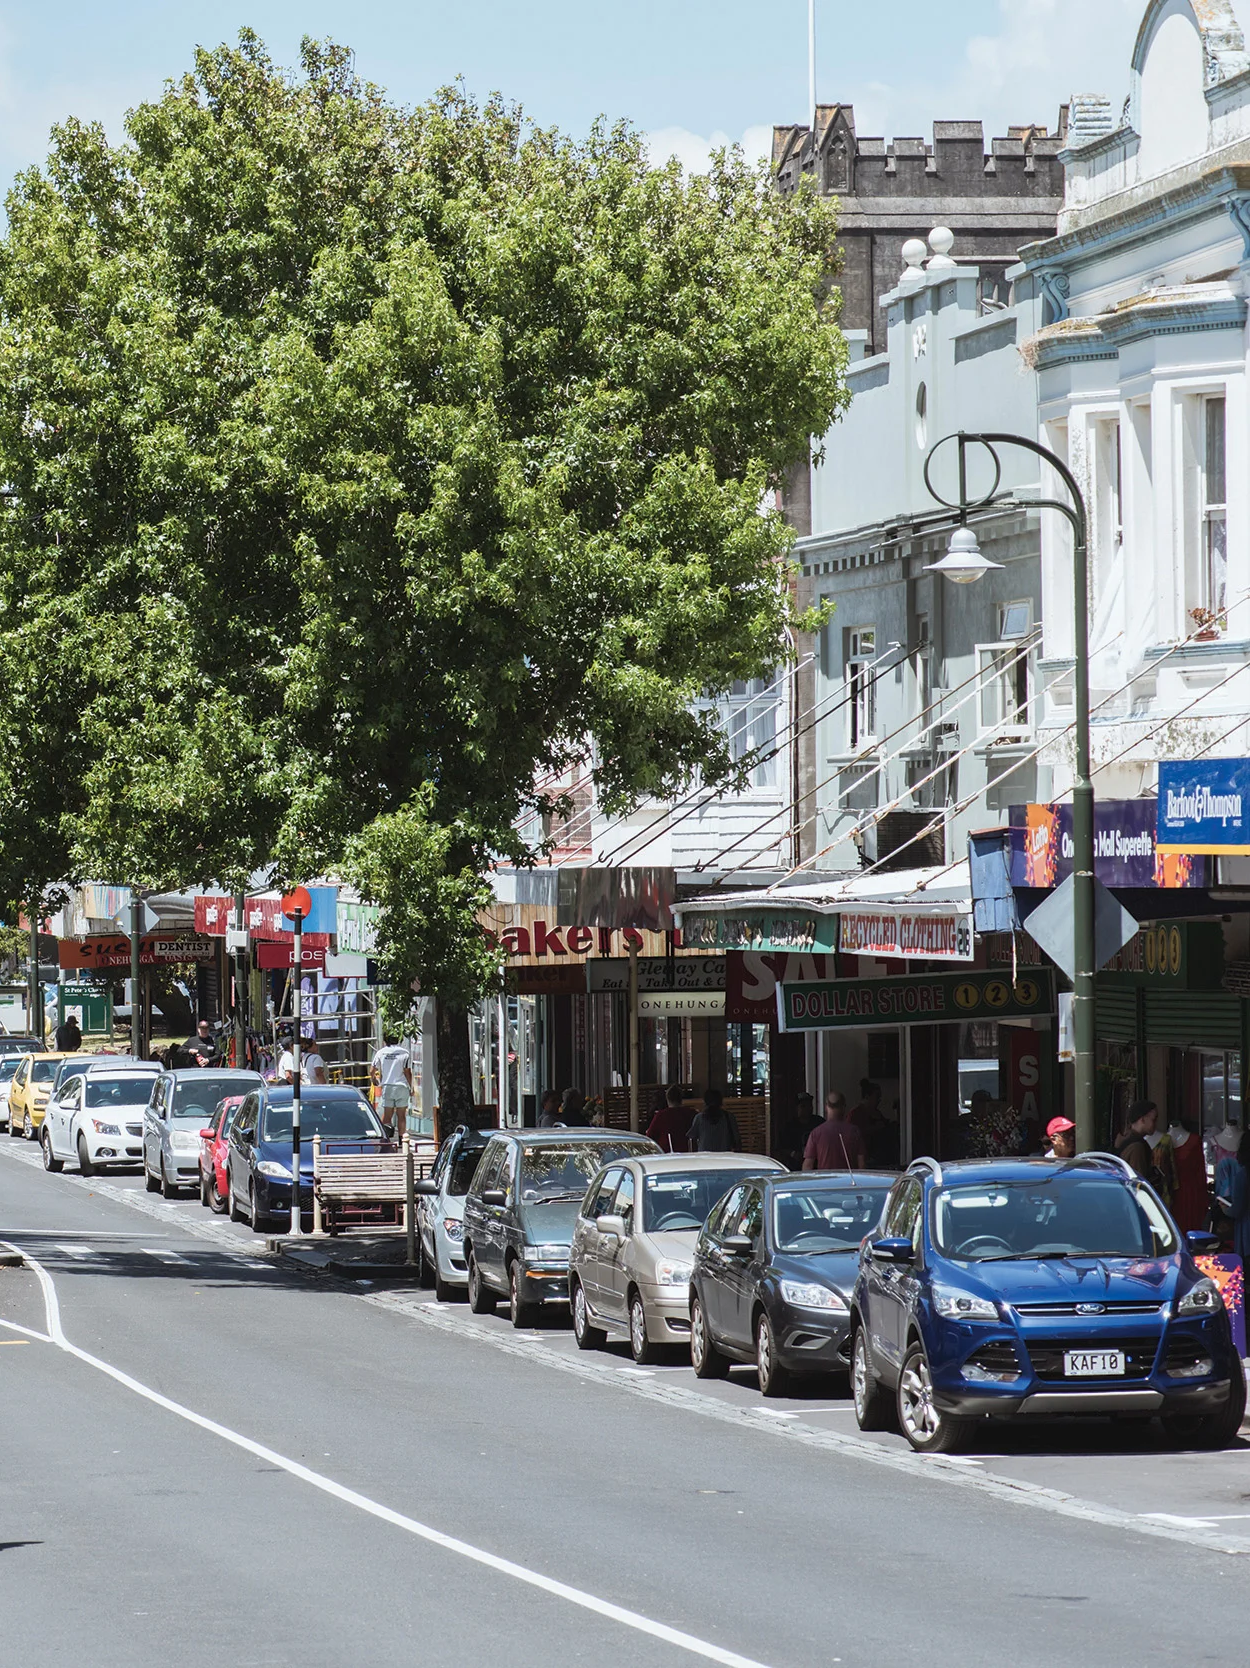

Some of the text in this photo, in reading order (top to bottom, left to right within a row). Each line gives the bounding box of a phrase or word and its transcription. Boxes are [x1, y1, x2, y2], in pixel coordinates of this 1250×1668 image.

[1099, 830, 1114, 857] Mall
[1115, 830, 1152, 863] Superette
[159, 942, 211, 951] DENTIST
[841, 913, 897, 951] RECYCLED
[900, 916, 956, 955] CLOTHING
[645, 978, 674, 988] Tak
[678, 977, 700, 988] Out
[791, 988, 876, 1018] DOLLAR
[878, 985, 945, 1014] STORE
